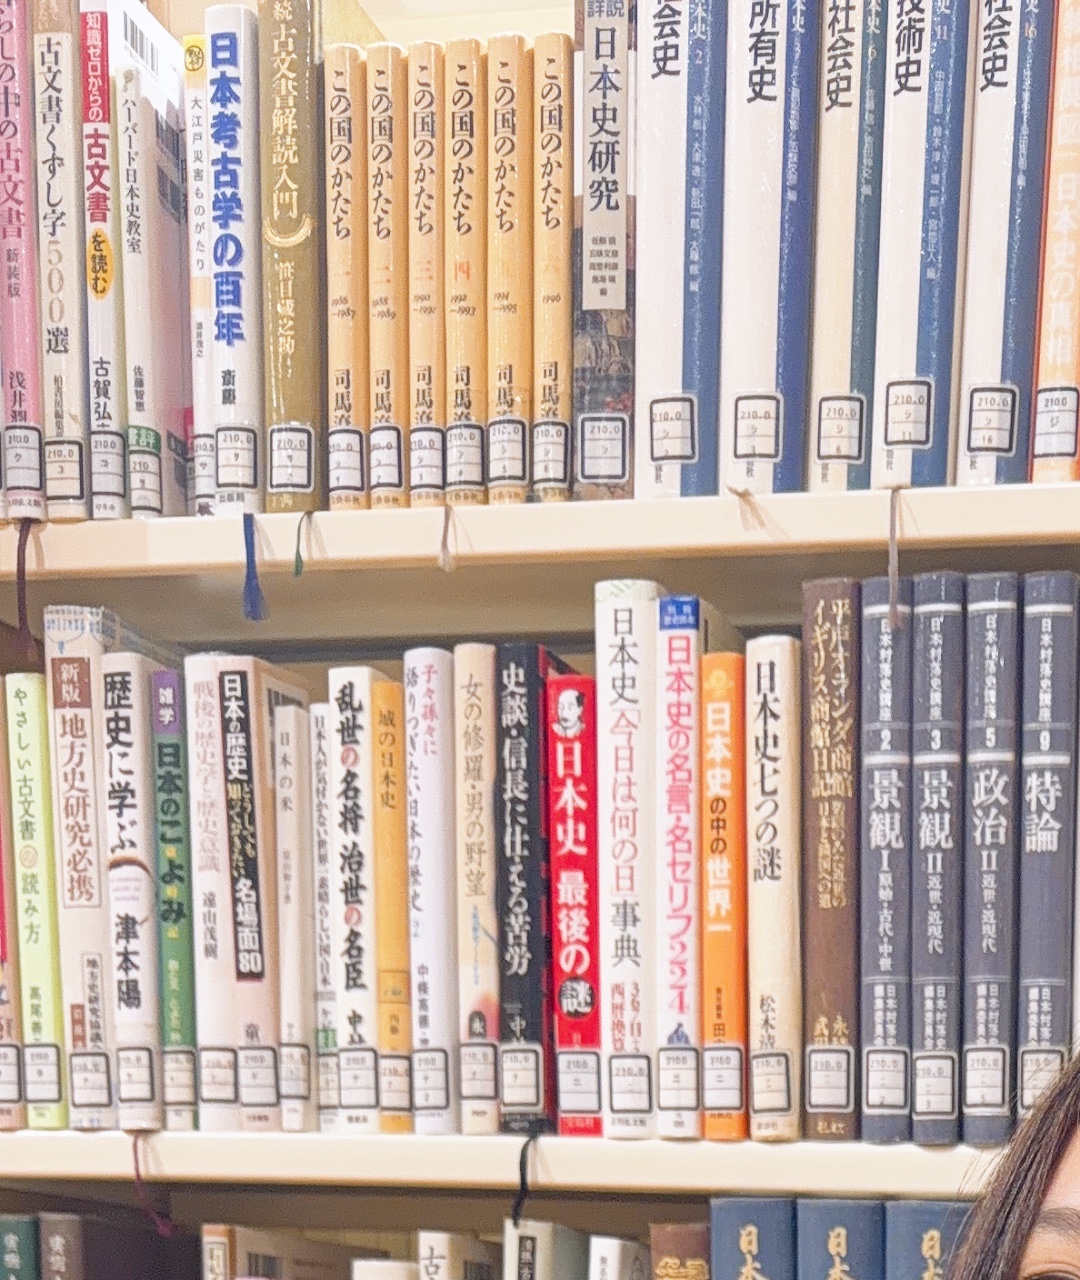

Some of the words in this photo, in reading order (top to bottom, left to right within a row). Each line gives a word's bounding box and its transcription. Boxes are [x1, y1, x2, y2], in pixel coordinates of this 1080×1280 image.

[37, 37, 70, 355] 古文書くずし字500選
[121, 97, 142, 255] ハーバード日本史教室
[191, 97, 206, 272] 大江戸災害ものがたり
[210, 32, 244, 347] 日本考古学の百年
[330, 70, 352, 240] この国のかたち
[370, 69, 394, 240] この国のかたち
[412, 63, 435, 236] この国のかたち
[452, 63, 473, 236] この国のかたち
[493, 61, 518, 233] この国のかたち
[539, 58, 562, 230] この国のかたち
[587, 26, 621, 213] 日本史研究
[58, 664, 82, 702] 新版
[158, 686, 175, 725] 雑学
[221, 674, 248, 781] 日本の歴史
[336, 681, 366, 836] 乱世の名将
[377, 709, 398, 809] 城の日本史
[880, 729, 892, 752] 2
[931, 730, 941, 751] 3
[985, 728, 996, 748] 5
[1039, 730, 1050, 751] 9
[13, 687, 40, 945] やさしい古文書の読み方
[58, 715, 95, 903] 地方史研究必携
[103, 672, 139, 853] 歴史に学ぶ
[501, 661, 532, 977] 史談・信長に仕える苦労
[556, 740, 588, 857] 日本史
[608, 607, 641, 968] 日本史「今日は何の日」事典
[664, 636, 693, 1016] 日本史の名言・名セリフ224
[706, 704, 734, 932] 日本史の中の世界一
[752, 660, 784, 884] 日本史七つの謎
[869, 771, 904, 848] 景観
[919, 770, 953, 848] 景観
[973, 767, 1007, 845] 政治
[1025, 774, 1062, 853] 特論
[113, 913, 142, 1010] 津本陽
[233, 876, 263, 974] 名場面80
[338, 840, 368, 993] 治世の名臣
[556, 870, 594, 1018] 最後の謎
